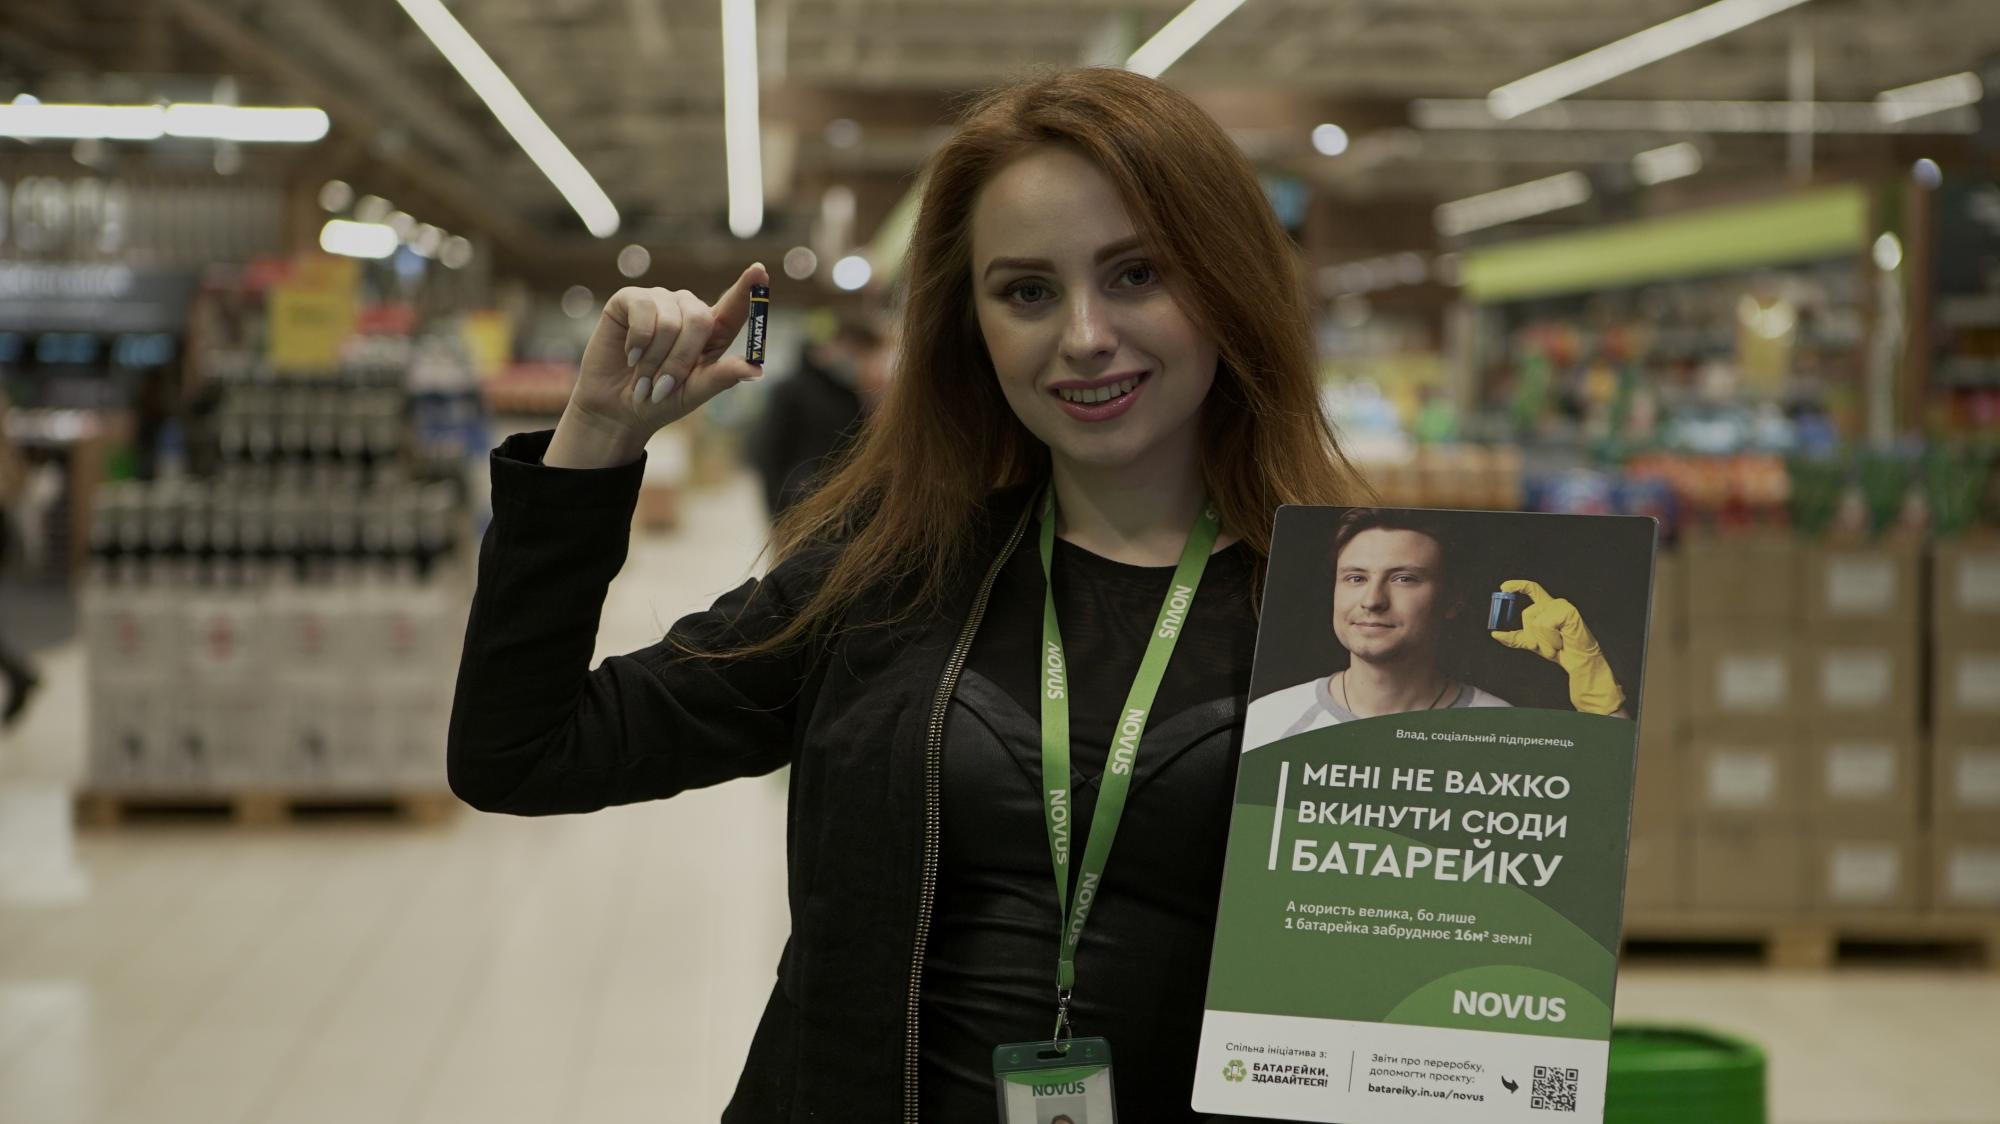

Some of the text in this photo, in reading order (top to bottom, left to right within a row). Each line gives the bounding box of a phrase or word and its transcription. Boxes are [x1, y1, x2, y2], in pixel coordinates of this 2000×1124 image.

[753, 315, 764, 350] VARTA
[1158, 585, 1193, 639] NOVUS
[1047, 641, 1065, 699] NOVUS
[1111, 709, 1145, 775] NOVUS
[1396, 729, 1575, 748] Влад, соціальний підприємець
[1303, 763, 1571, 799] МЕНІ НЕ ВАЖКО
[1049, 789, 1067, 865] NOVUS
[1298, 801, 1568, 840] ВКИНУТИ СЮДИ
[1291, 839, 1563, 887] БАТАРЕЙКУ
[1068, 872, 1099, 946] NOVUS
[1286, 901, 1476, 924] А користь велика, бо лише
[1285, 918, 1293, 929] 1
[1296, 918, 1369, 935] батарейка
[1372, 924, 1451, 940] забруднює
[1492, 932, 1532, 945] землі
[1453, 990, 1566, 1022] NOVUS
[1226, 1043, 1328, 1059] Спільна ініціатива з:
[1371, 1054, 1485, 1073] Звіти про переробку,
[1251, 1074, 1328, 1087] ЗДАВАЙТЕСЯ!
[1253, 1063, 1329, 1077] БАТАРЕЙКИ,
[1369, 1068, 1475, 1085] допомогти проєкту:
[1031, 1081, 1086, 1098] NOVUS
[1368, 1083, 1484, 1101] batareiky.in.ua/novus
